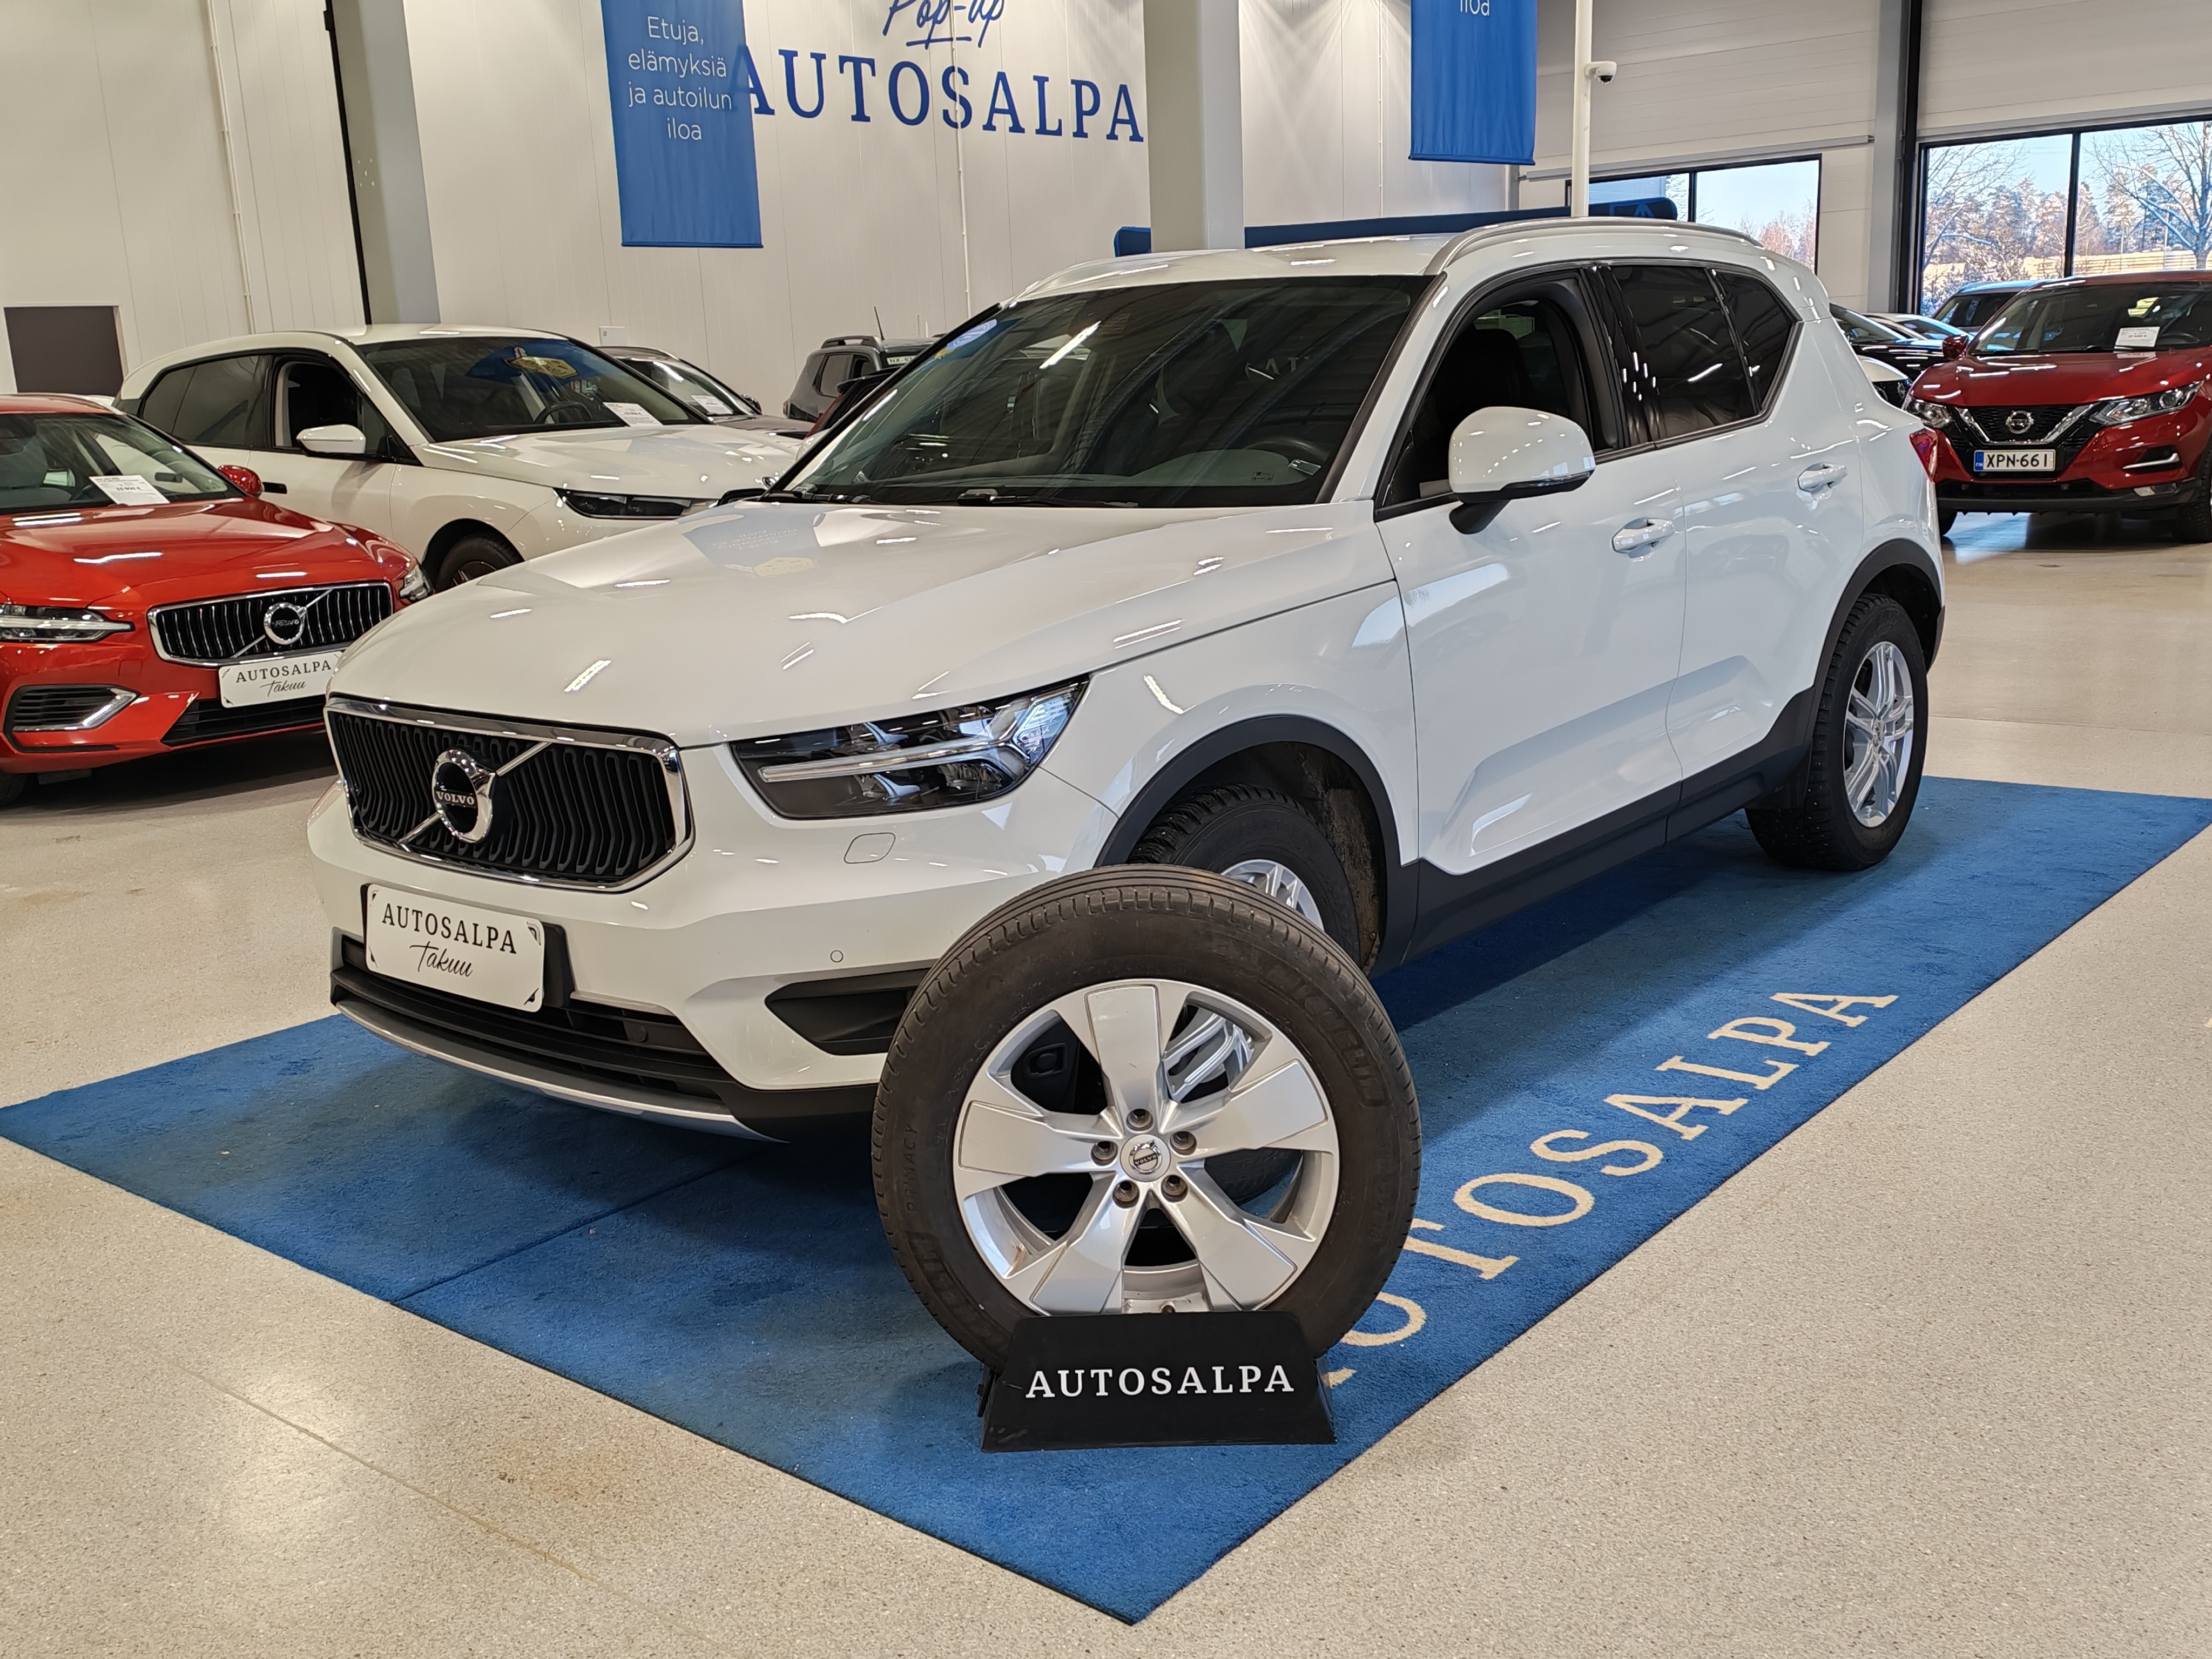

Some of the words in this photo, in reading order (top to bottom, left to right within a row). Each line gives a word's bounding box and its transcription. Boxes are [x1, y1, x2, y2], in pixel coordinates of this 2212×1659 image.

[648, 16, 704, 45] Etuja,
[628, 48, 727, 78] elämyksiä
[628, 81, 646, 107] ja
[653, 86, 732, 110] autoilun
[729, 44, 1144, 143] AUTOSALPA
[667, 117, 702, 141] iloa
[1986, 454, 2047, 468] XPN-661
[235, 660, 332, 683] AUTOSALPA
[260, 680, 306, 697] Takuu
[436, 791, 475, 805] VOLVO
[382, 903, 517, 954] AUTOSALPA
[409, 941, 473, 977] Takuu
[1134, 1155, 1157, 1165] VOLVO
[1026, 1365, 1294, 1399] AUTOSALPA
